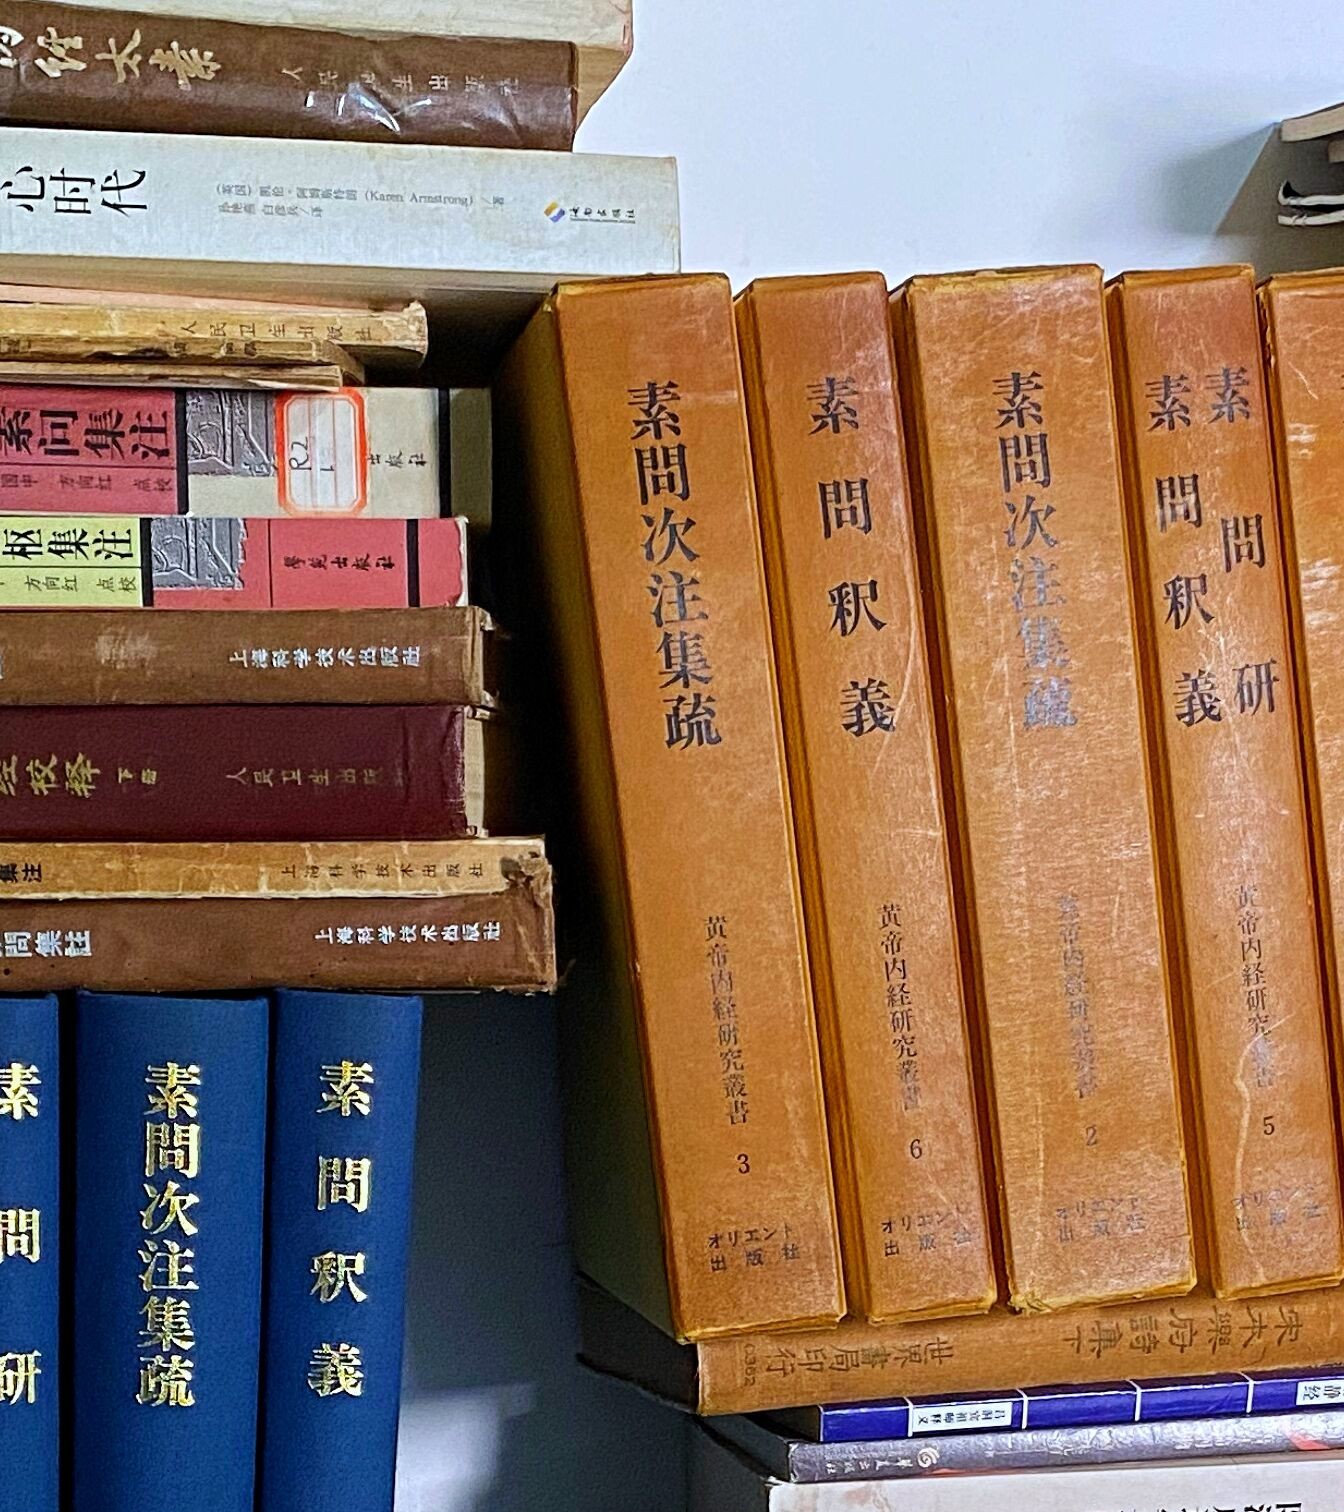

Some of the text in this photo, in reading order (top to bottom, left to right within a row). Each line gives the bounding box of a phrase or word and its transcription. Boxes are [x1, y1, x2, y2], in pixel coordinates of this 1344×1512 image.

[627, 380, 723, 751] 素問次注集疏
[806, 375, 897, 740] 素問釈義
[1146, 375, 1223, 729] 素問釈義
[25, 576, 79, 593] 方向红
[96, 575, 137, 593] 点校
[1084, 1125, 1099, 1148] 2
[1261, 1116, 1276, 1137] 5
[736, 1153, 752, 1174] 3
[908, 1138, 924, 1159] 6
[135, 1061, 202, 1409] 素問次注集疏
[306, 1059, 373, 1399] 素問釈義
[709, 1244, 802, 1274] 出版社
